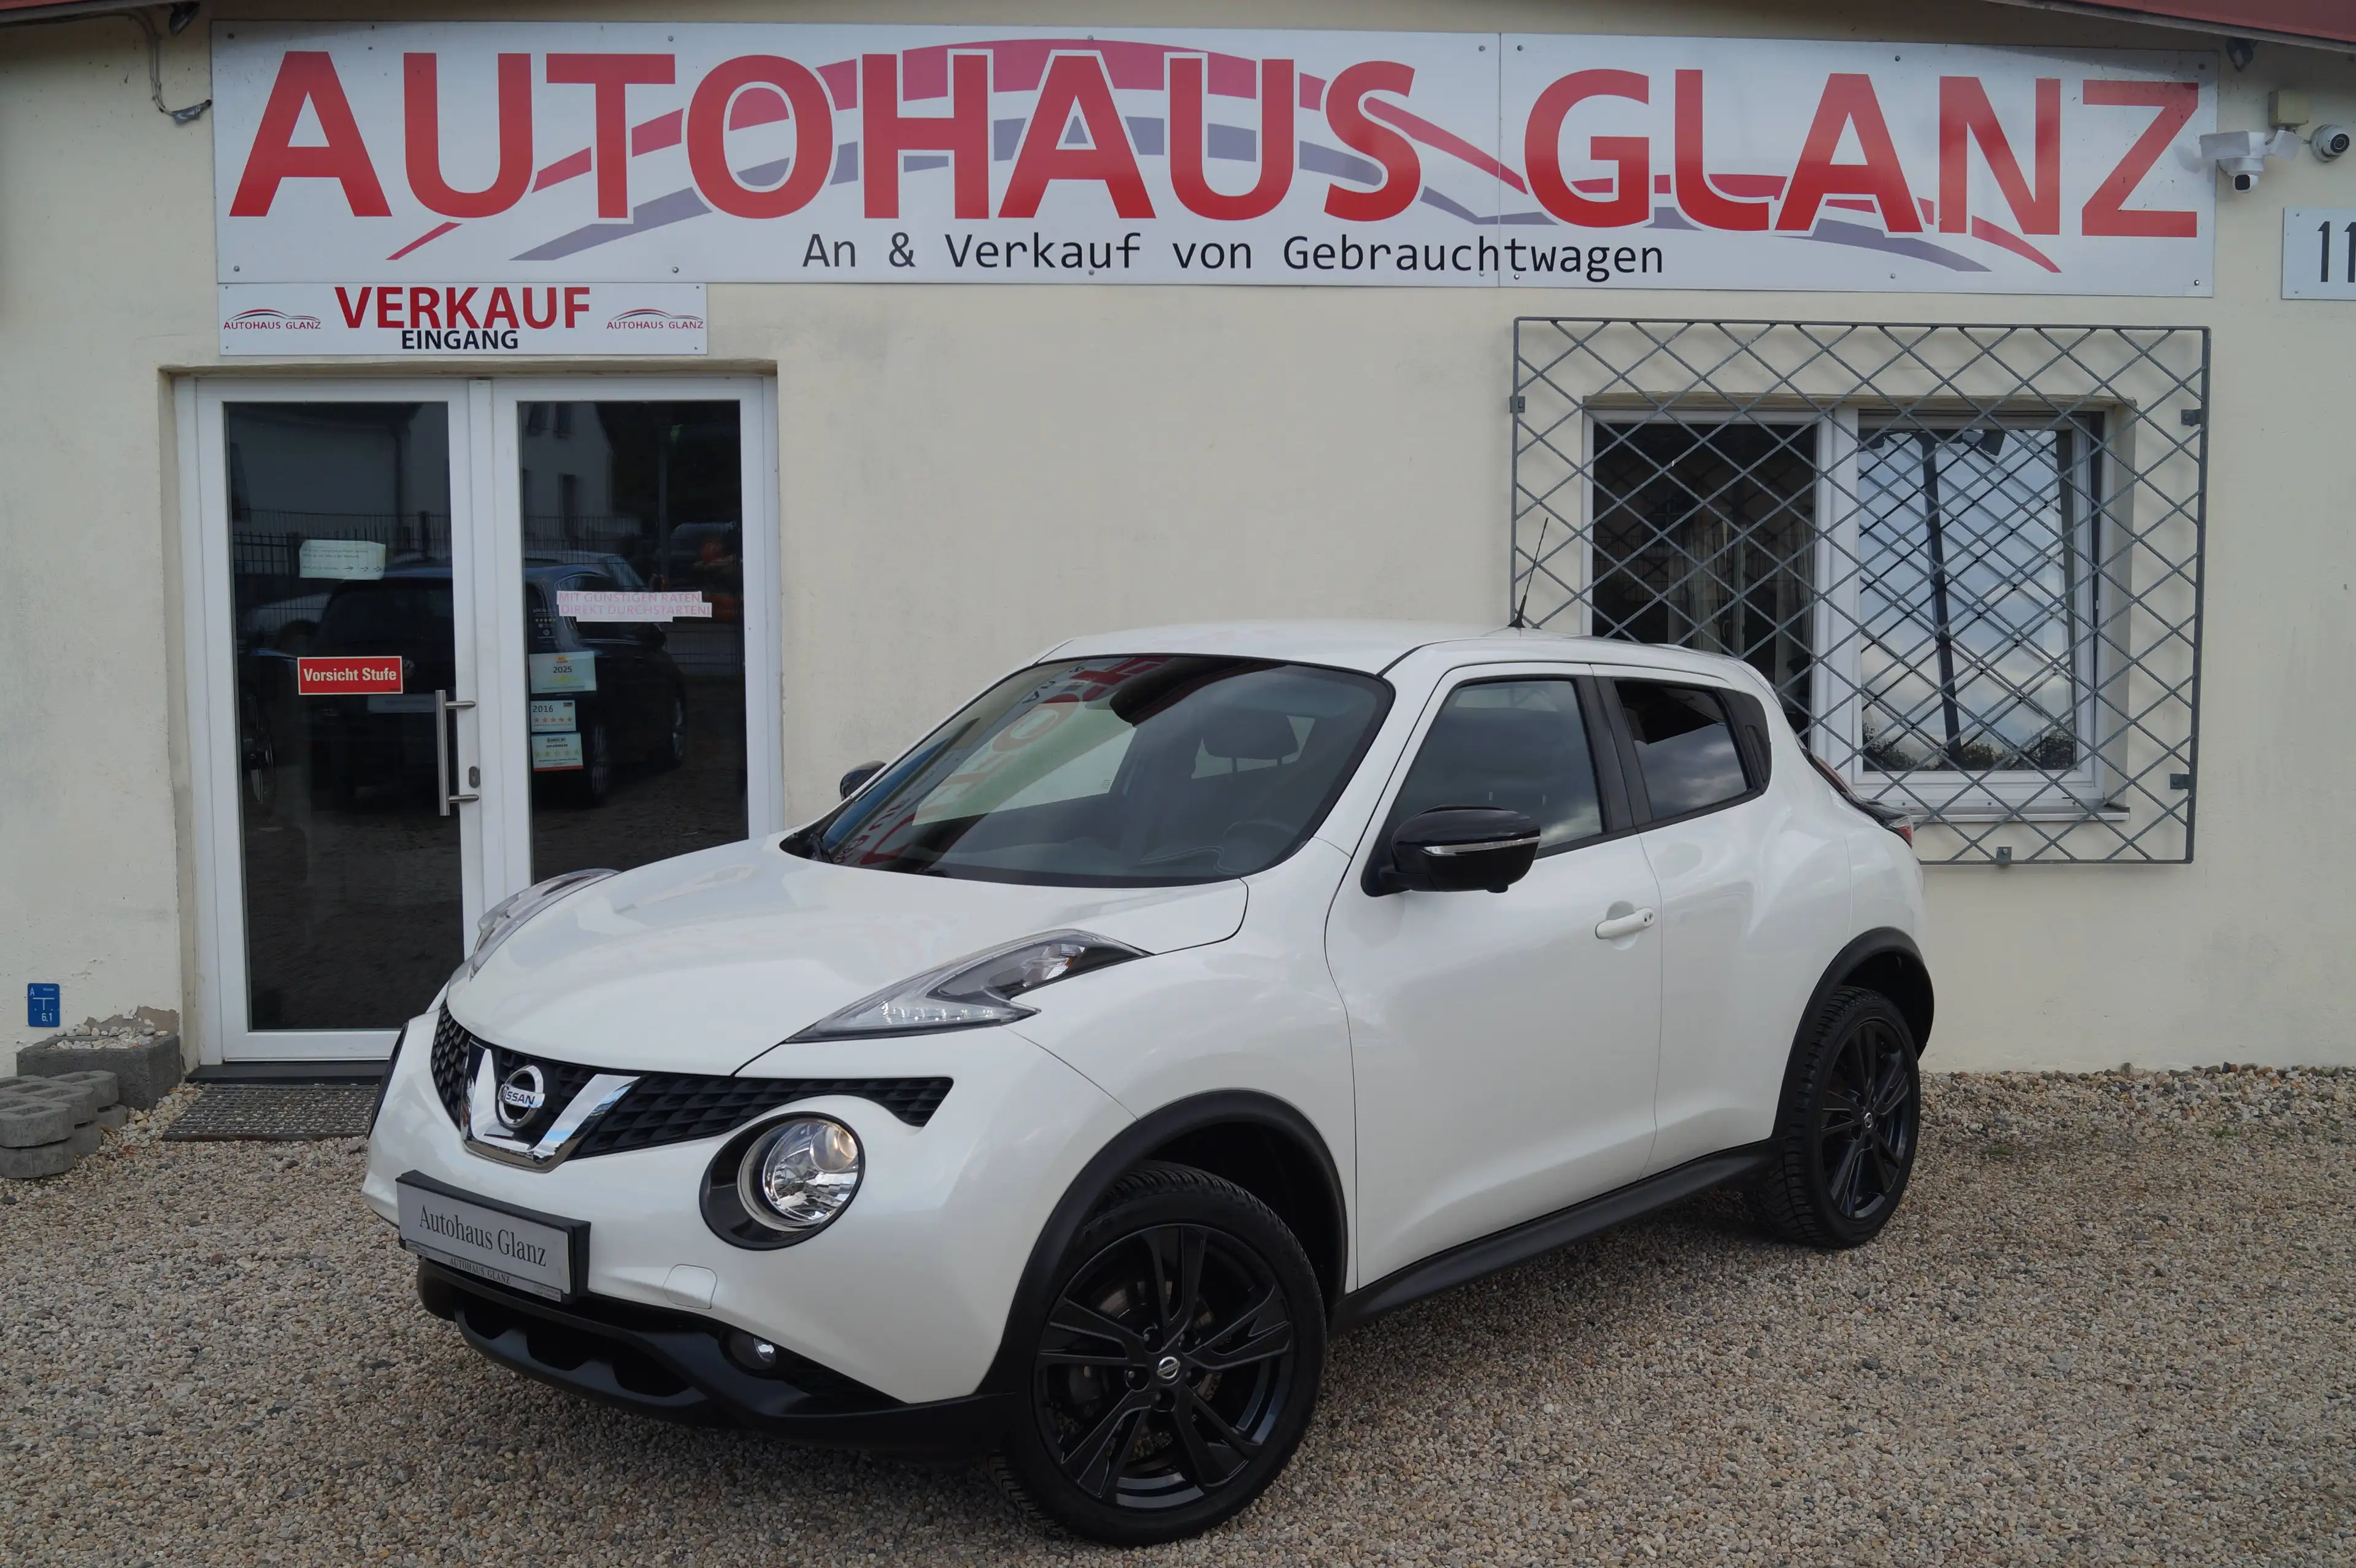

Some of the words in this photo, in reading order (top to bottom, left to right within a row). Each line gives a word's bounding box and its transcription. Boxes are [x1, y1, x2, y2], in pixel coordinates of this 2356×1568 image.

[229, 51, 1421, 221] AUTOHAUS
[1525, 68, 2199, 238] GLANZ
[803, 234, 855, 267] An
[889, 232, 915, 267] &
[945, 232, 1141, 268] Verkauf
[1172, 243, 1251, 269] von
[1284, 234, 1662, 282] Gebrauchtwagen
[336, 286, 590, 329] VERKAUF
[223, 321, 281, 330] AUTOHAUS
[606, 321, 664, 329] AUTOHAUS
[401, 330, 519, 349] EINGANG
[559, 593, 580, 602] MIT
[661, 593, 700, 603] RATEN
[561, 605, 604, 615] DIREKT
[303, 668, 359, 682] Vorsicht
[362, 667, 397, 681] Stufe
[41, 1012, 53, 1022] 6.1
[420, 1205, 493, 1250] Autohaus
[498, 1229, 547, 1267] Glanz
[449, 1258, 485, 1276] AUTOHAUS
[487, 1269, 510, 1285] GLANZ
